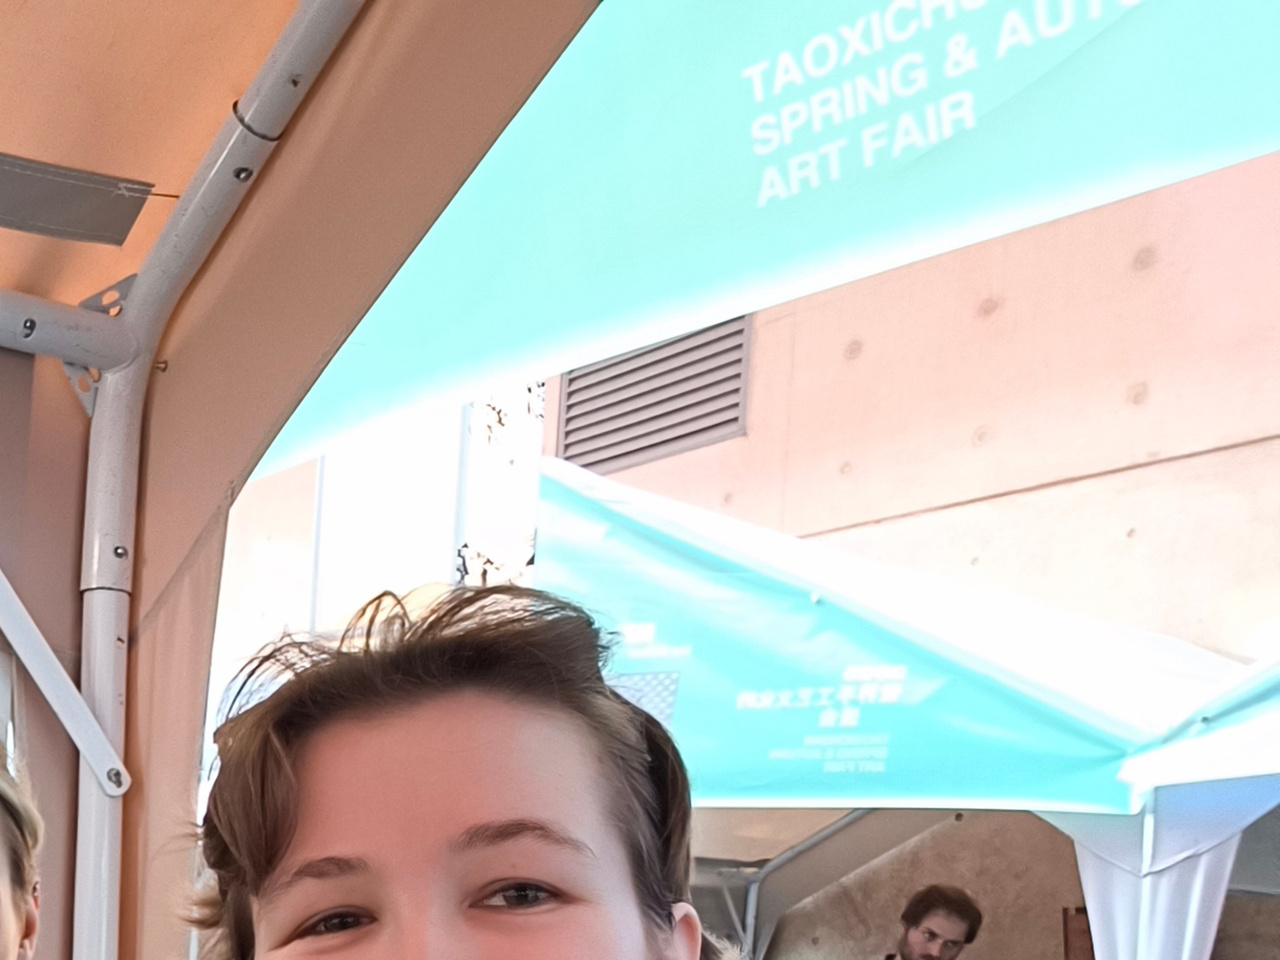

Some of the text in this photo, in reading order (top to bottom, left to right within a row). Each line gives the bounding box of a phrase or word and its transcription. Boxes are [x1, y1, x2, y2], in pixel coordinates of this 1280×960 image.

[741, 0, 989, 104] TAOXICH
[750, 0, 1143, 157] SPRING & AU
[756, 90, 977, 209] ART FAIR
